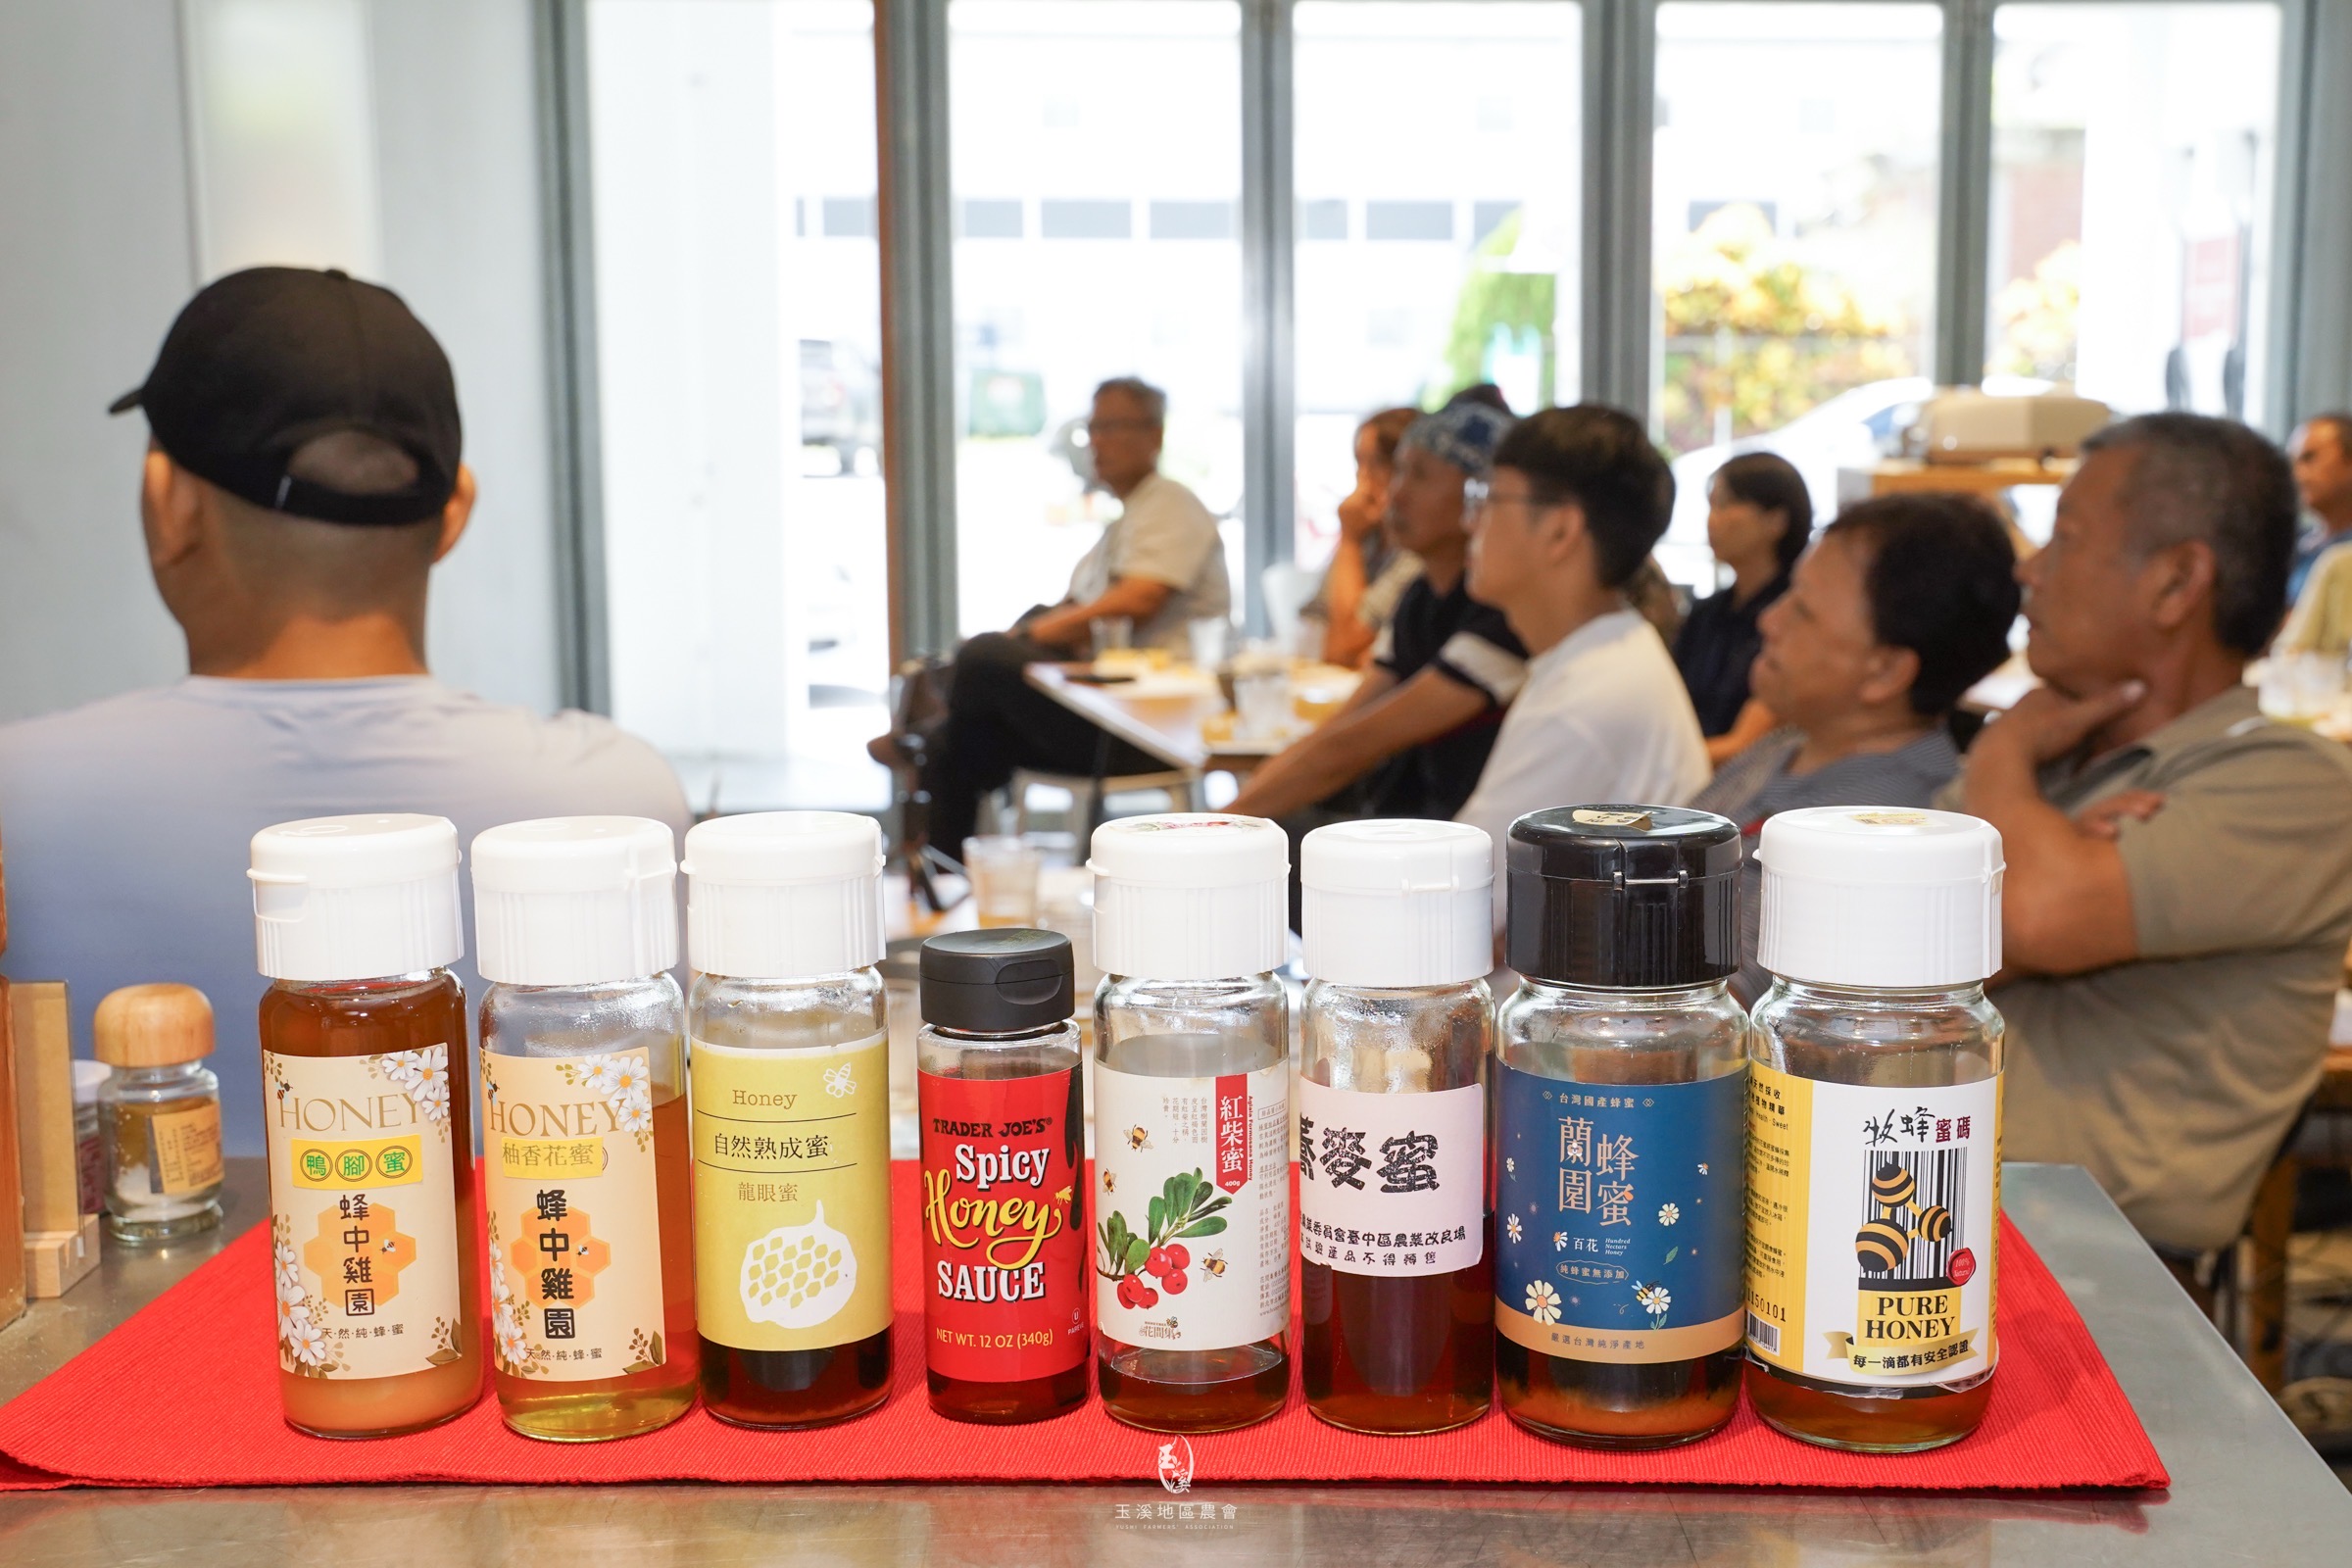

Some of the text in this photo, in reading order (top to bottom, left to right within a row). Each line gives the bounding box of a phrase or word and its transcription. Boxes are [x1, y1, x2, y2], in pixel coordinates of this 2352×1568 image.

[732, 1089, 798, 1109] Honey
[1559, 1093, 1635, 1108] 台灣國產蜂蜜
[279, 1093, 419, 1132] HONEY
[489, 1098, 626, 1137] HONEY
[933, 1118, 994, 1138] TRADER
[1219, 1095, 1244, 1174] 紅柴蜜
[502, 1143, 594, 1167] 柚香花蜜
[714, 1133, 829, 1160] 自然熟成蜜
[306, 1152, 406, 1176] 鴨腳蜜
[955, 1144, 1051, 1191] Spicy
[1558, 1115, 1593, 1214] 蘭園
[738, 1181, 799, 1202] 龍眼蜜
[1224, 1179, 1241, 1188] 400g
[1595, 1133, 1640, 1227] 蜂蜜
[923, 1168, 1062, 1270] Honey
[340, 1194, 374, 1316] 蜂中雞園
[1573, 1237, 1598, 1252] 百花
[536, 1189, 576, 1340] 蜂中雞園
[1559, 1263, 1626, 1279] 純蜂蜜無添加
[937, 1260, 1046, 1302] SAUCE
[1876, 1295, 1949, 1317] PURE
[936, 1328, 1054, 1349] NET WT. 12 OZ (340g)
[1865, 1316, 1955, 1340] HONEY
[1853, 1339, 1969, 1369] 每一滴都有安全認證
